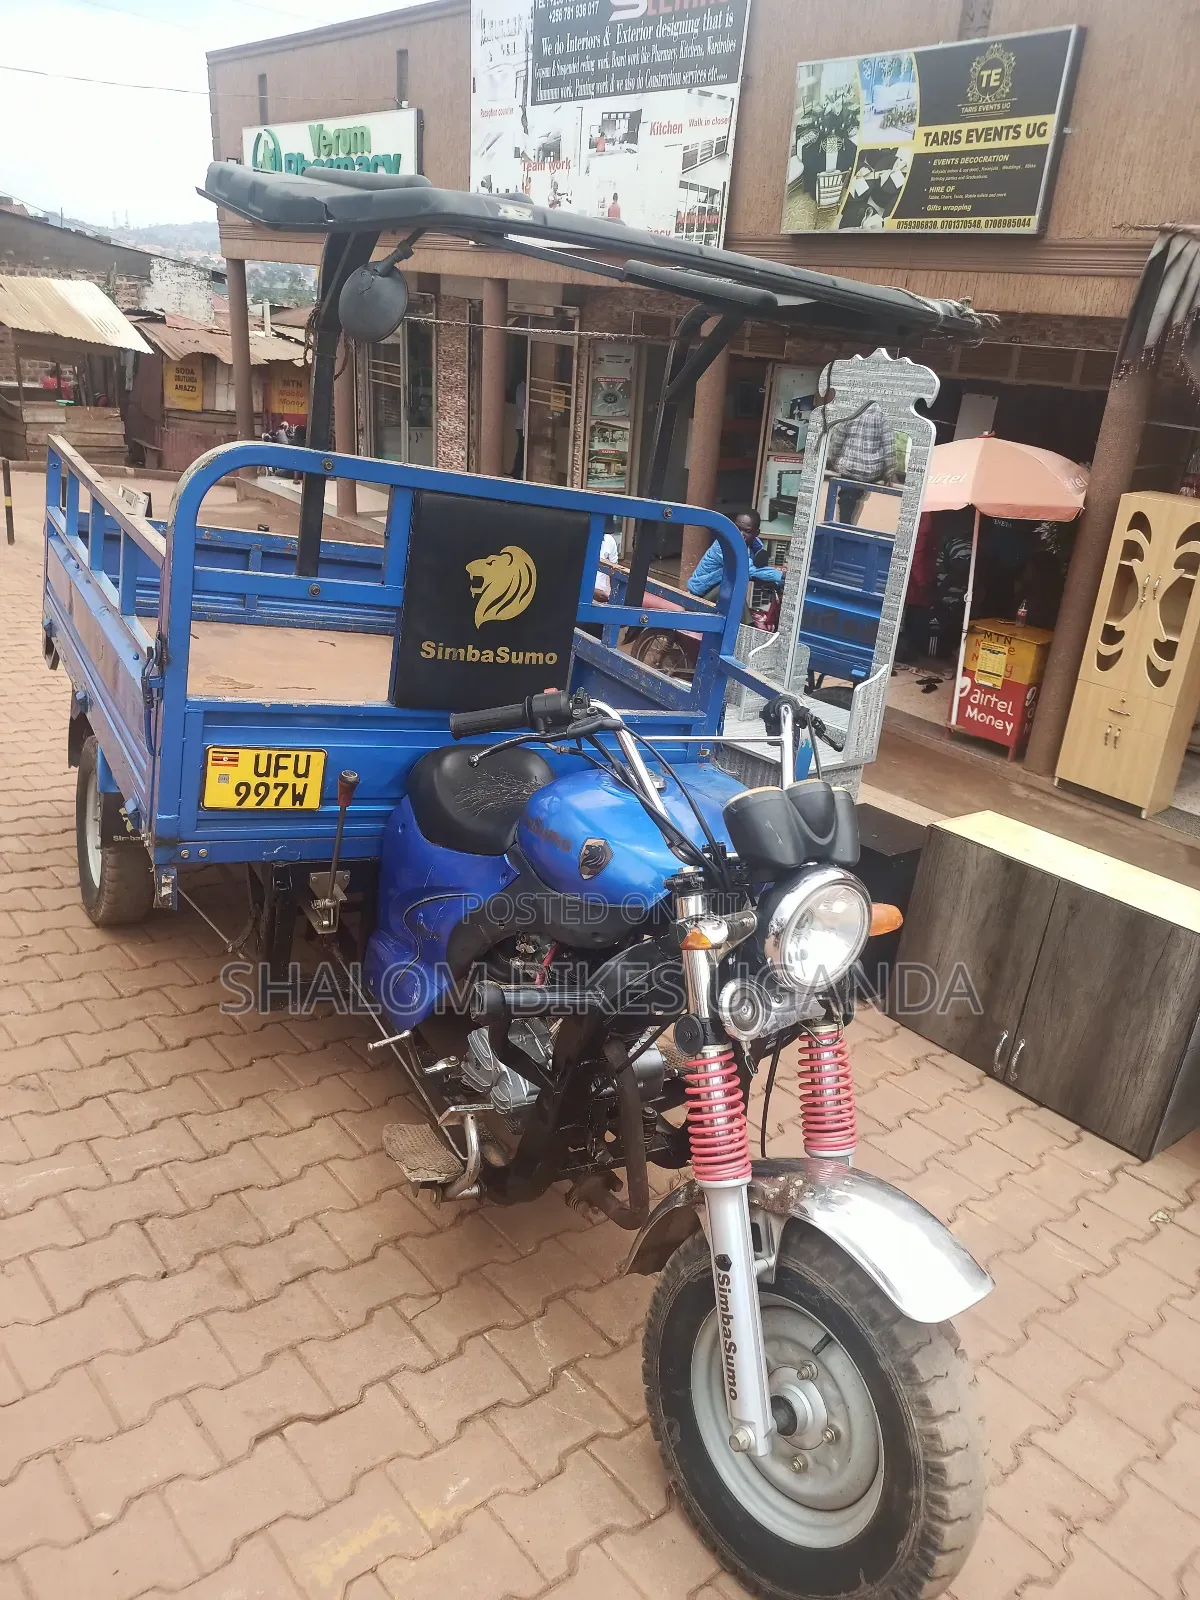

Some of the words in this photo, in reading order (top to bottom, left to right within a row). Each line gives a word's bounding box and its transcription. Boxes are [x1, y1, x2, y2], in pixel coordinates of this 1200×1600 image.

[549, 9, 563, 24] +256
[563, 5, 574, 20] 781
[575, 3, 587, 18] 936
[587, 0, 600, 15] 017
[542, 37, 553, 56] We
[555, 35, 564, 55] do
[566, 29, 601, 53] Interiors
[603, 25, 611, 47] &
[616, 20, 653, 44] Exterior
[655, 12, 700, 42] designing
[702, 7, 722, 31] that
[725, 5, 734, 28] is
[645, 67, 682, 88] Construction
[683, 64, 707, 84] services
[980, 68, 1002, 88] TE
[961, 105, 978, 114] TARIS
[978, 103, 1000, 112] EVENTS
[650, 120, 683, 136] Kitchen
[688, 118, 703, 127] Walk
[704, 118, 711, 126] in
[924, 130, 963, 147] TARIS
[965, 123, 1022, 144] EVENTS
[1025, 121, 1048, 139] UG
[522, 160, 545, 172] Team
[548, 157, 571, 171] work
[933, 157, 959, 166] EVENTS
[926, 203, 941, 212] Gifts
[942, 203, 972, 212] wrapping
[175, 367, 195, 375] SODA
[283, 380, 303, 388] MTN
[983, 630, 1013, 645] MTN
[420, 640, 558, 665] SimbaSumo
[969, 688, 1014, 716] airtel
[965, 704, 1014, 736] Money
[253, 753, 311, 778] UFU
[234, 782, 308, 807] 997W
[717, 1273, 738, 1401] SimbaSumo
